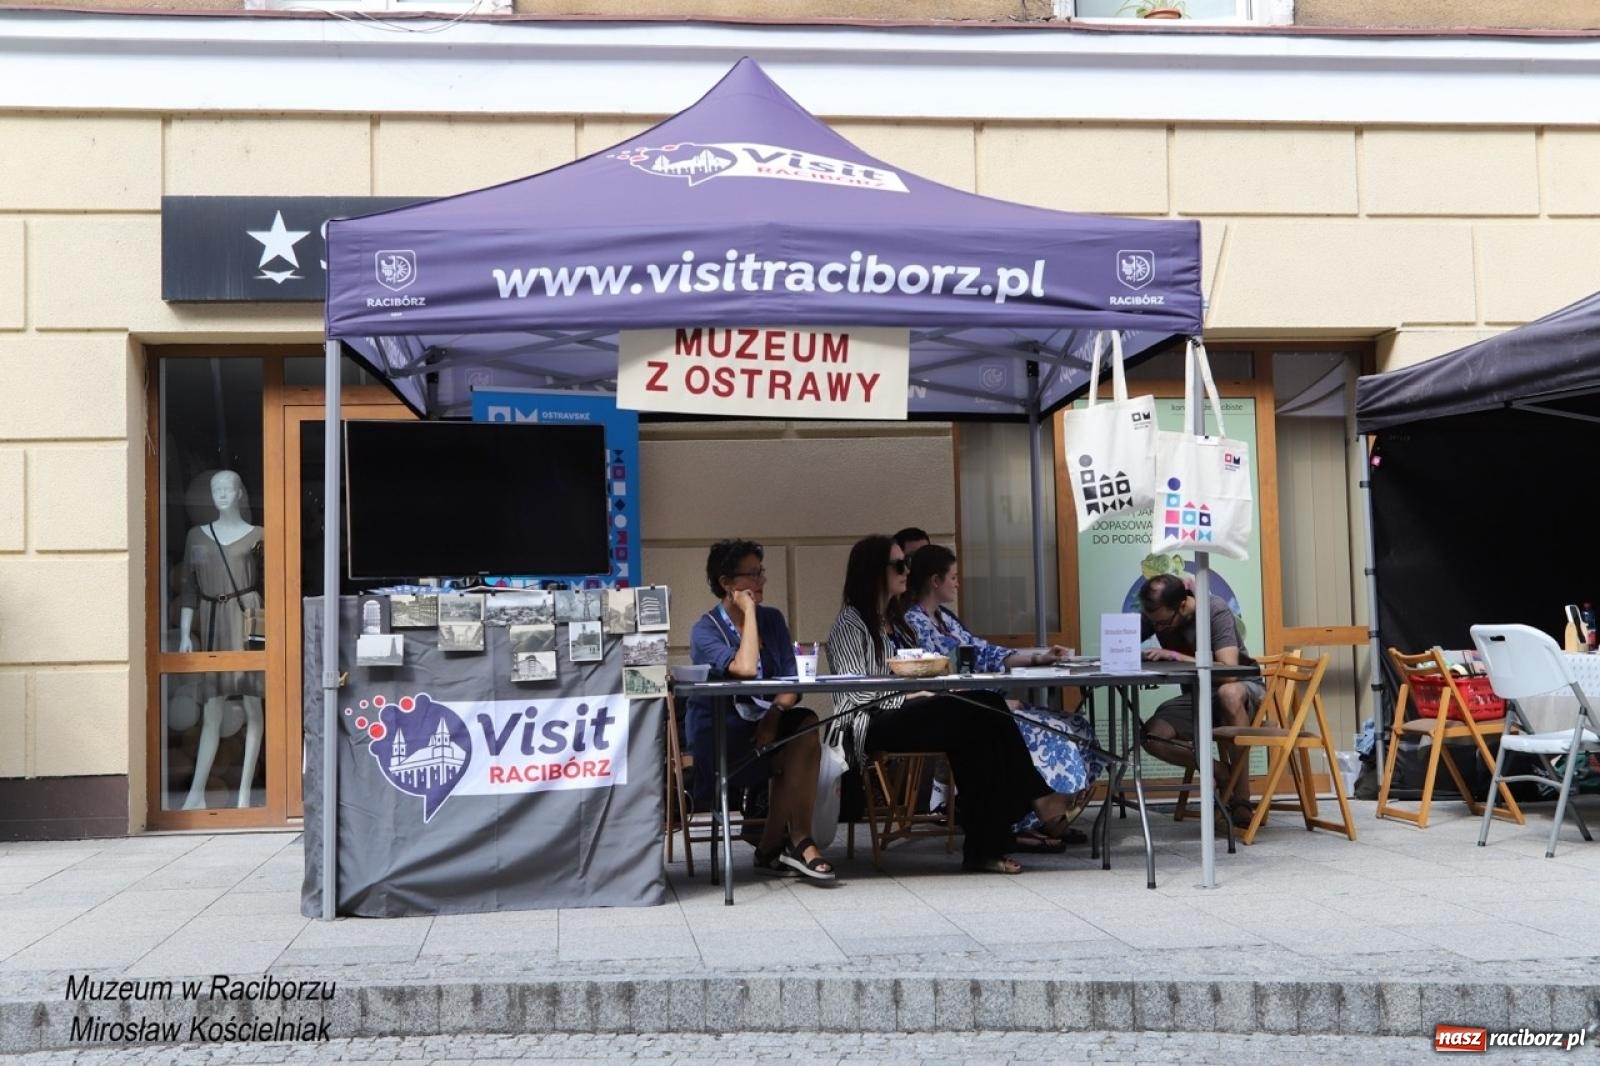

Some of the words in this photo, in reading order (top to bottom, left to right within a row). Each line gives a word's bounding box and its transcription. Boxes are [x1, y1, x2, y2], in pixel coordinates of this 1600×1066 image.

[742, 147, 884, 181] Visit
[492, 248, 1046, 303] www.visitraciborz.pl
[366, 294, 427, 307] RACIBÓRZ
[1109, 294, 1165, 306] RACIBÓRZ
[675, 327, 850, 364] MUZEUM
[645, 361, 670, 393] Z
[684, 365, 881, 403] OSTRAWY
[1093, 534, 1110, 545] DO
[476, 702, 616, 757] Visit
[489, 756, 611, 784] RACIBÓRZ
